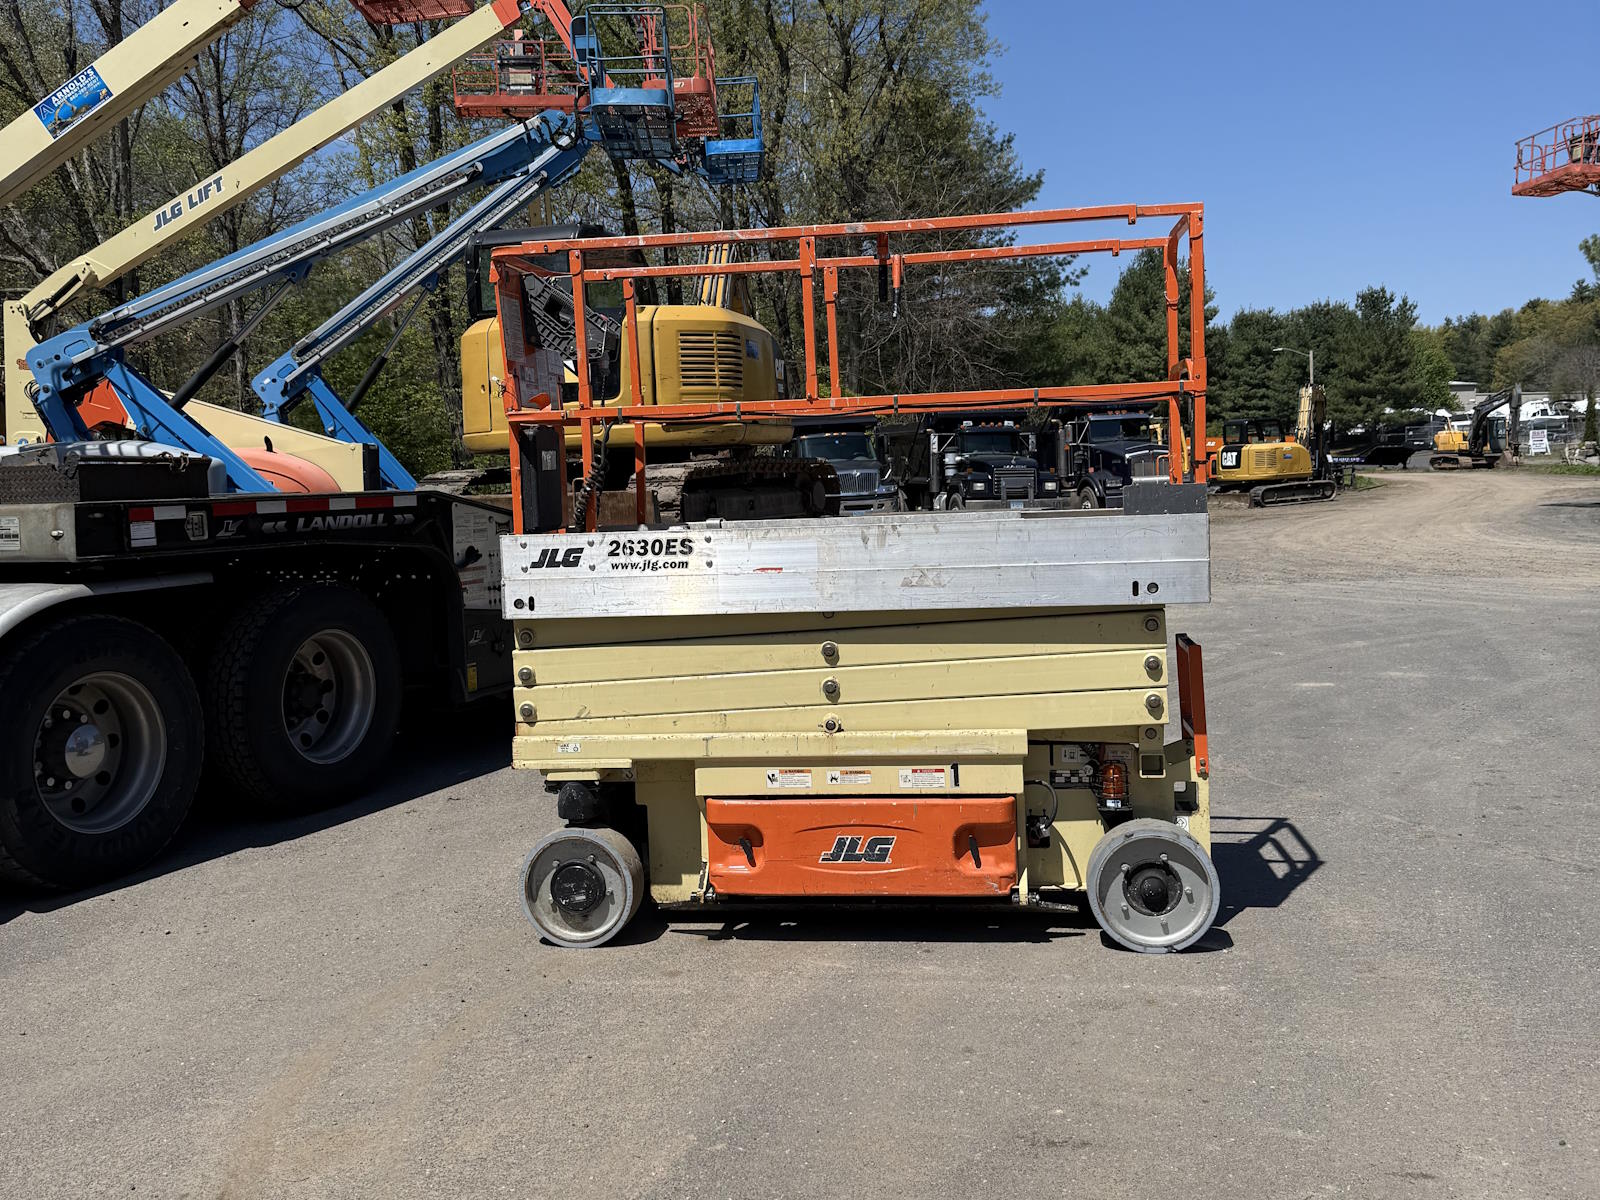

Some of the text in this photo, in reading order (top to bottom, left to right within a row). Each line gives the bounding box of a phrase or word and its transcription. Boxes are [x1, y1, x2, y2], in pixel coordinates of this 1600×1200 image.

[51, 68, 94, 105] ARNOLD'S
[153, 175, 223, 232] JLG LIFT
[1221, 451, 1238, 467] CAT
[296, 513, 388, 532] LANDOLL
[530, 538, 694, 569] JLG 2630ES
[611, 559, 689, 572] www.jlg.com
[818, 836, 897, 864] JLG
